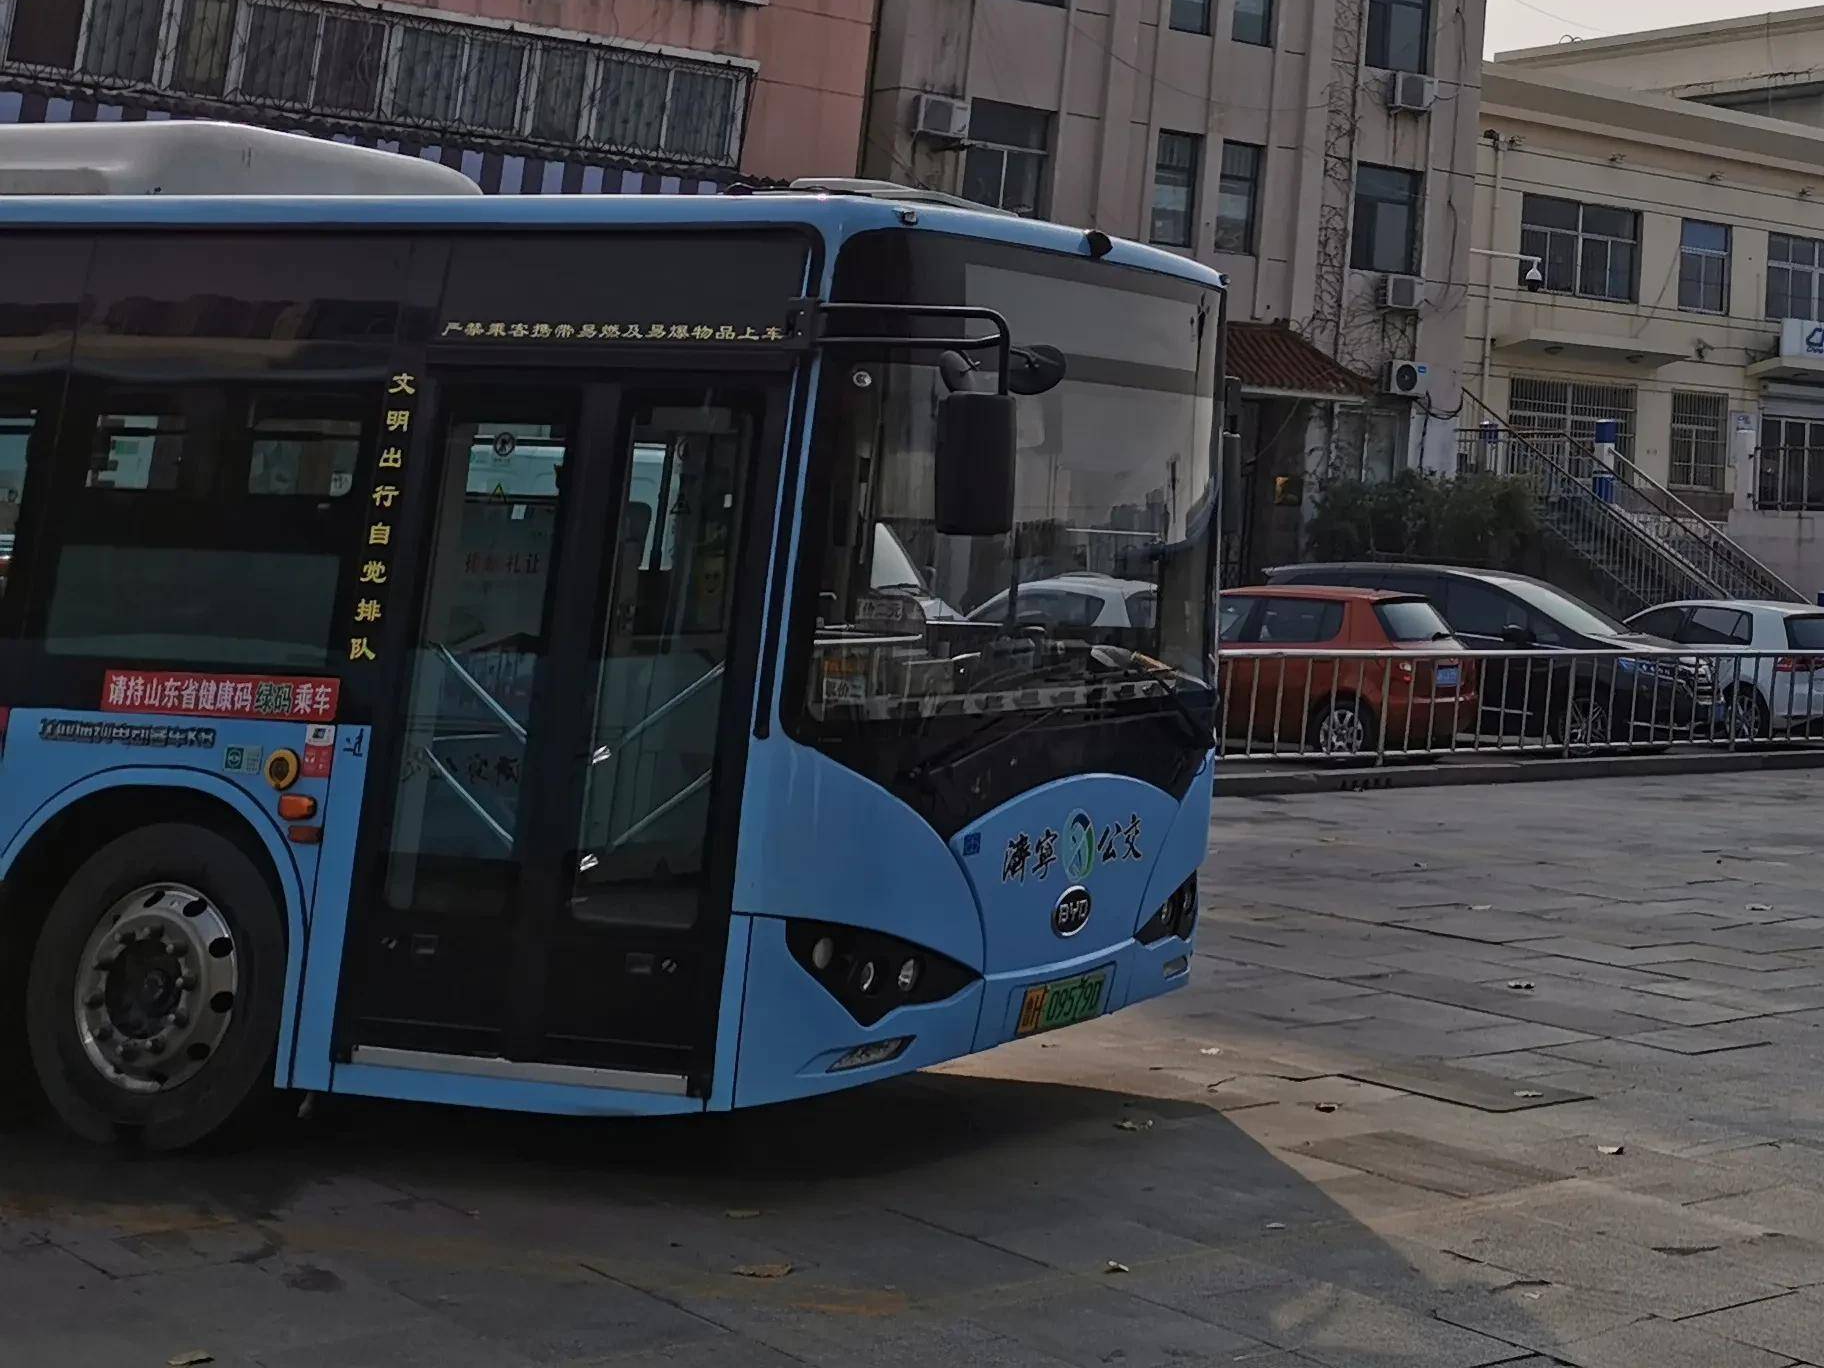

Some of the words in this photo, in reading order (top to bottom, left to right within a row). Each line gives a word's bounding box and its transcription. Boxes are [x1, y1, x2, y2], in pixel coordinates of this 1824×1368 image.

[350, 373, 415, 661] 文明出行自觉排队
[108, 675, 332, 715] 请持山东省健康码绿码乘车
[1058, 899, 1090, 924] BYD
